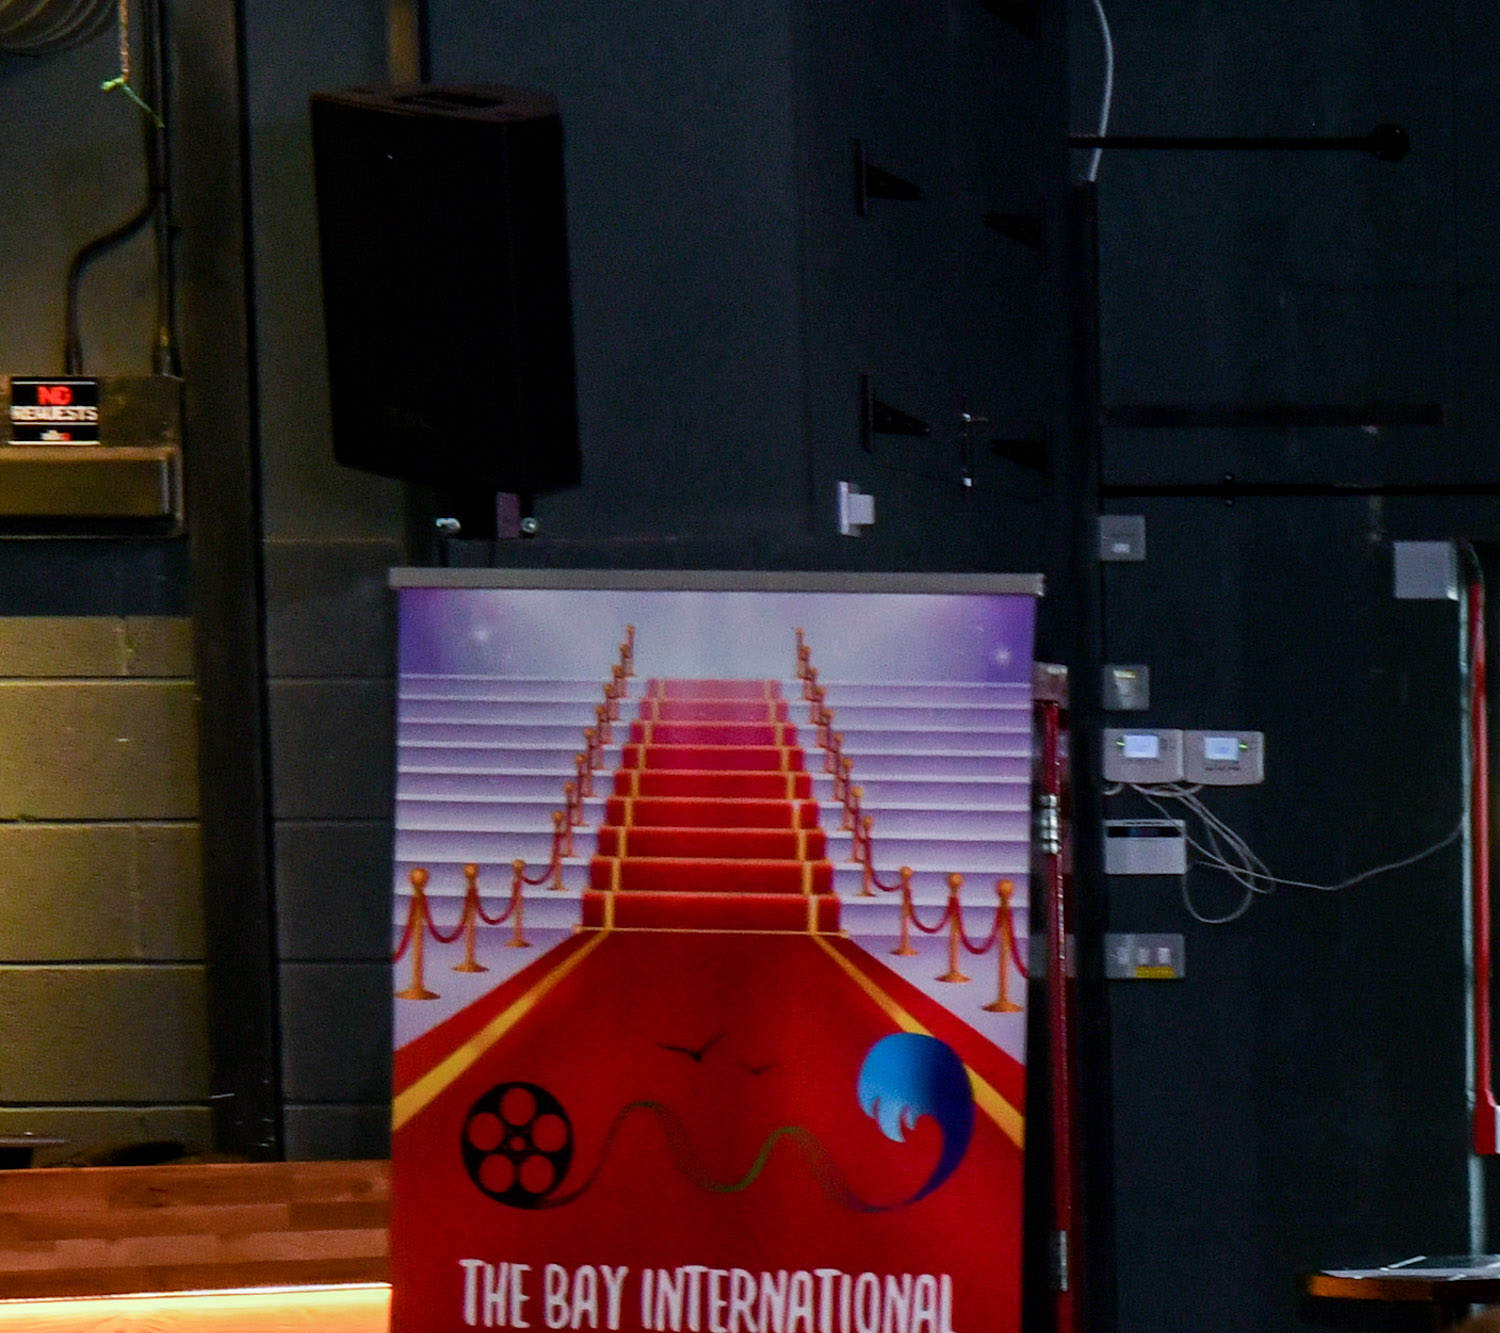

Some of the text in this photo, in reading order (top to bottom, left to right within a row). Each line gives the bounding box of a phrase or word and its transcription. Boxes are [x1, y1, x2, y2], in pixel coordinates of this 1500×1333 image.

[38, 385, 72, 406] NO
[458, 1259, 531, 1329] THE
[544, 1262, 628, 1331] BAY
